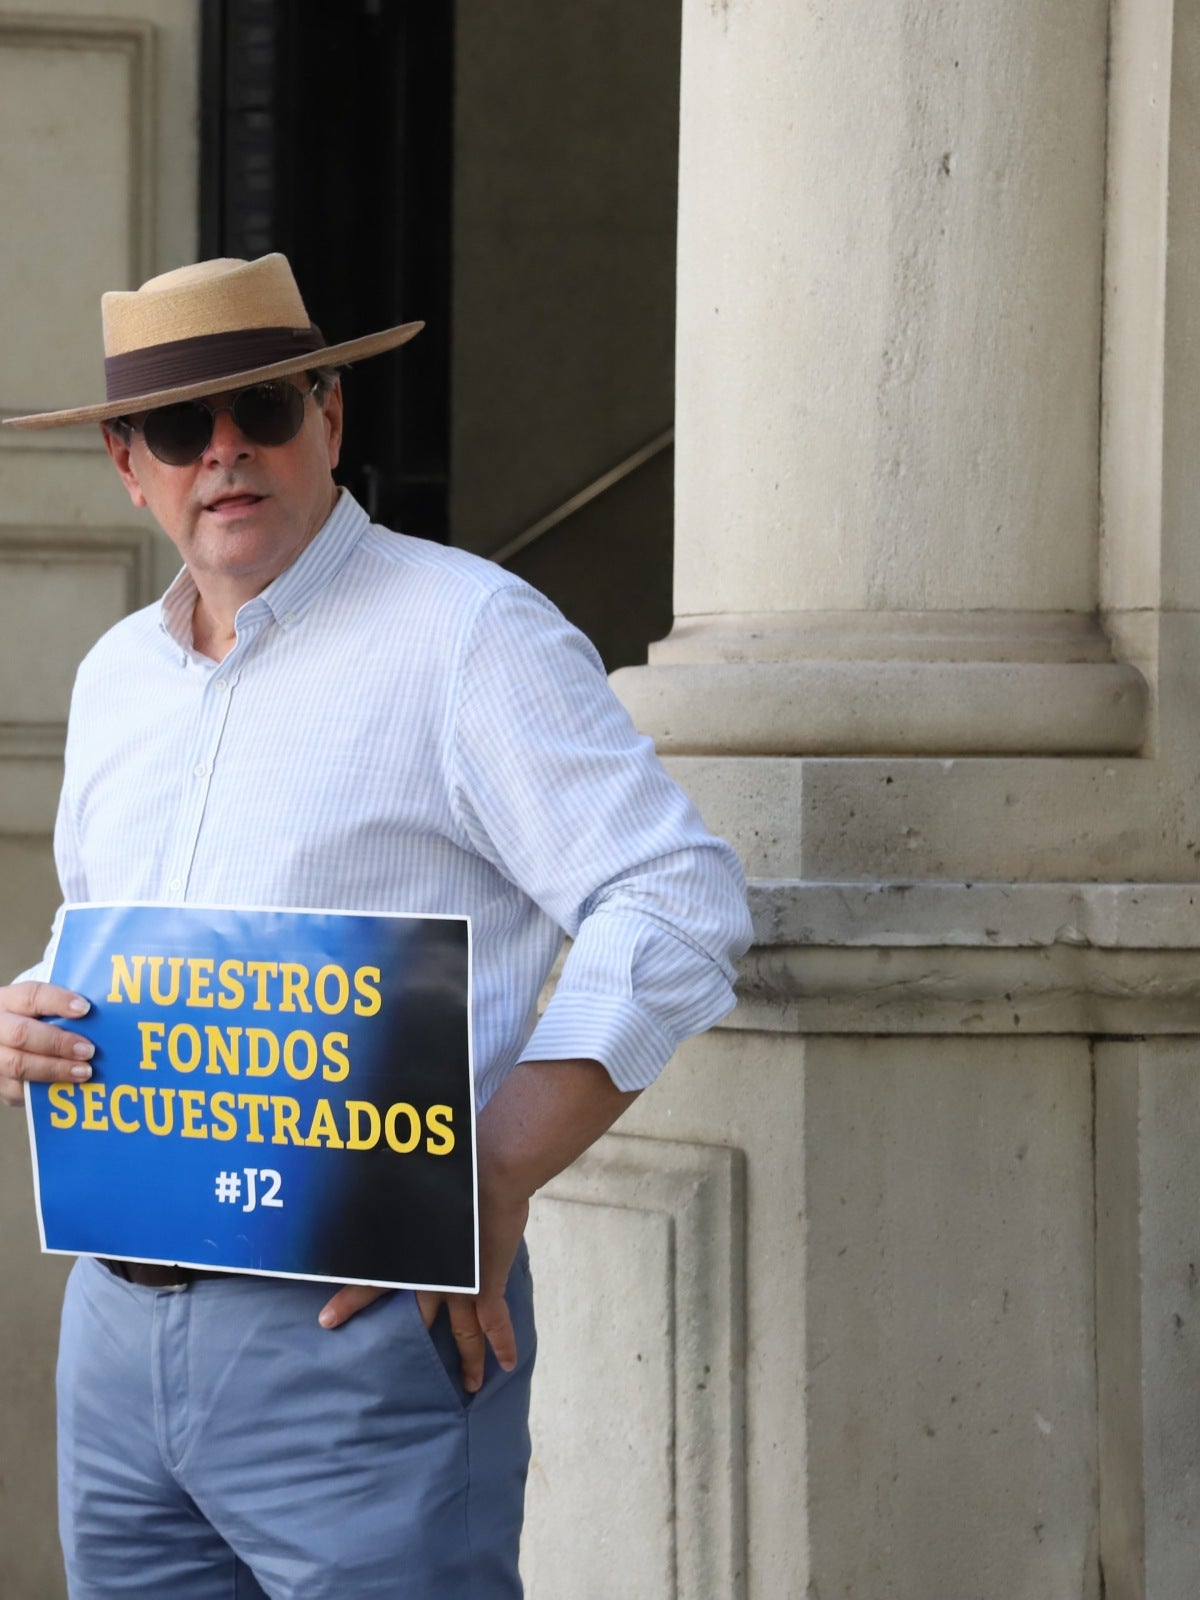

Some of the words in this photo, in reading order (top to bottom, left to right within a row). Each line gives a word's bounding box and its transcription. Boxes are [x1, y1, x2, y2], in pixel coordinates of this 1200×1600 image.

[107, 954, 383, 1017] NUESTROS
[137, 1021, 351, 1083] FONDOS
[47, 1082, 456, 1157] SECUESTRADOS
[215, 1168, 284, 1213] #J2
